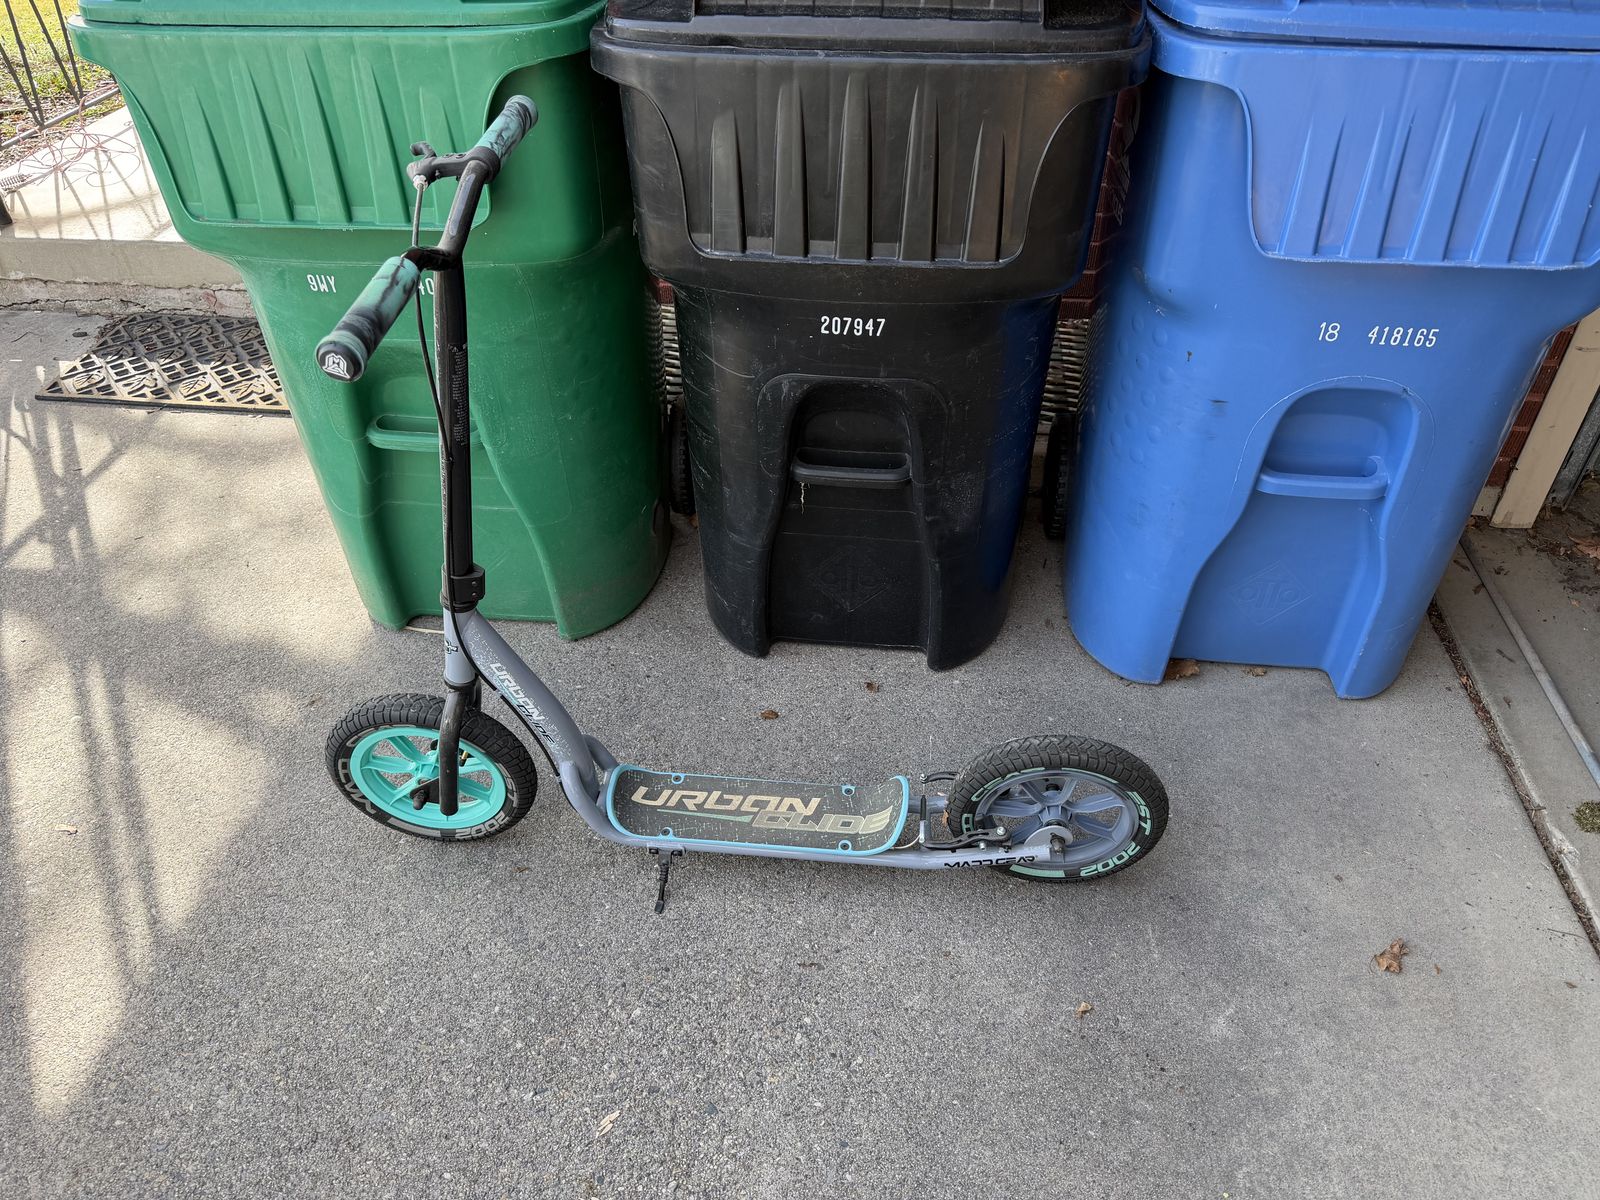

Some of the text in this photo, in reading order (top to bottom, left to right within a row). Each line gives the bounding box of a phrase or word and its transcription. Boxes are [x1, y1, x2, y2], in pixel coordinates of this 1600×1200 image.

[820, 315, 886, 337] 207947
[1318, 321, 1440, 348] 18 418165
[751, 805, 893, 836] GLIDE
[1126, 790, 1153, 836] EST
[1080, 841, 1141, 877] 2002
